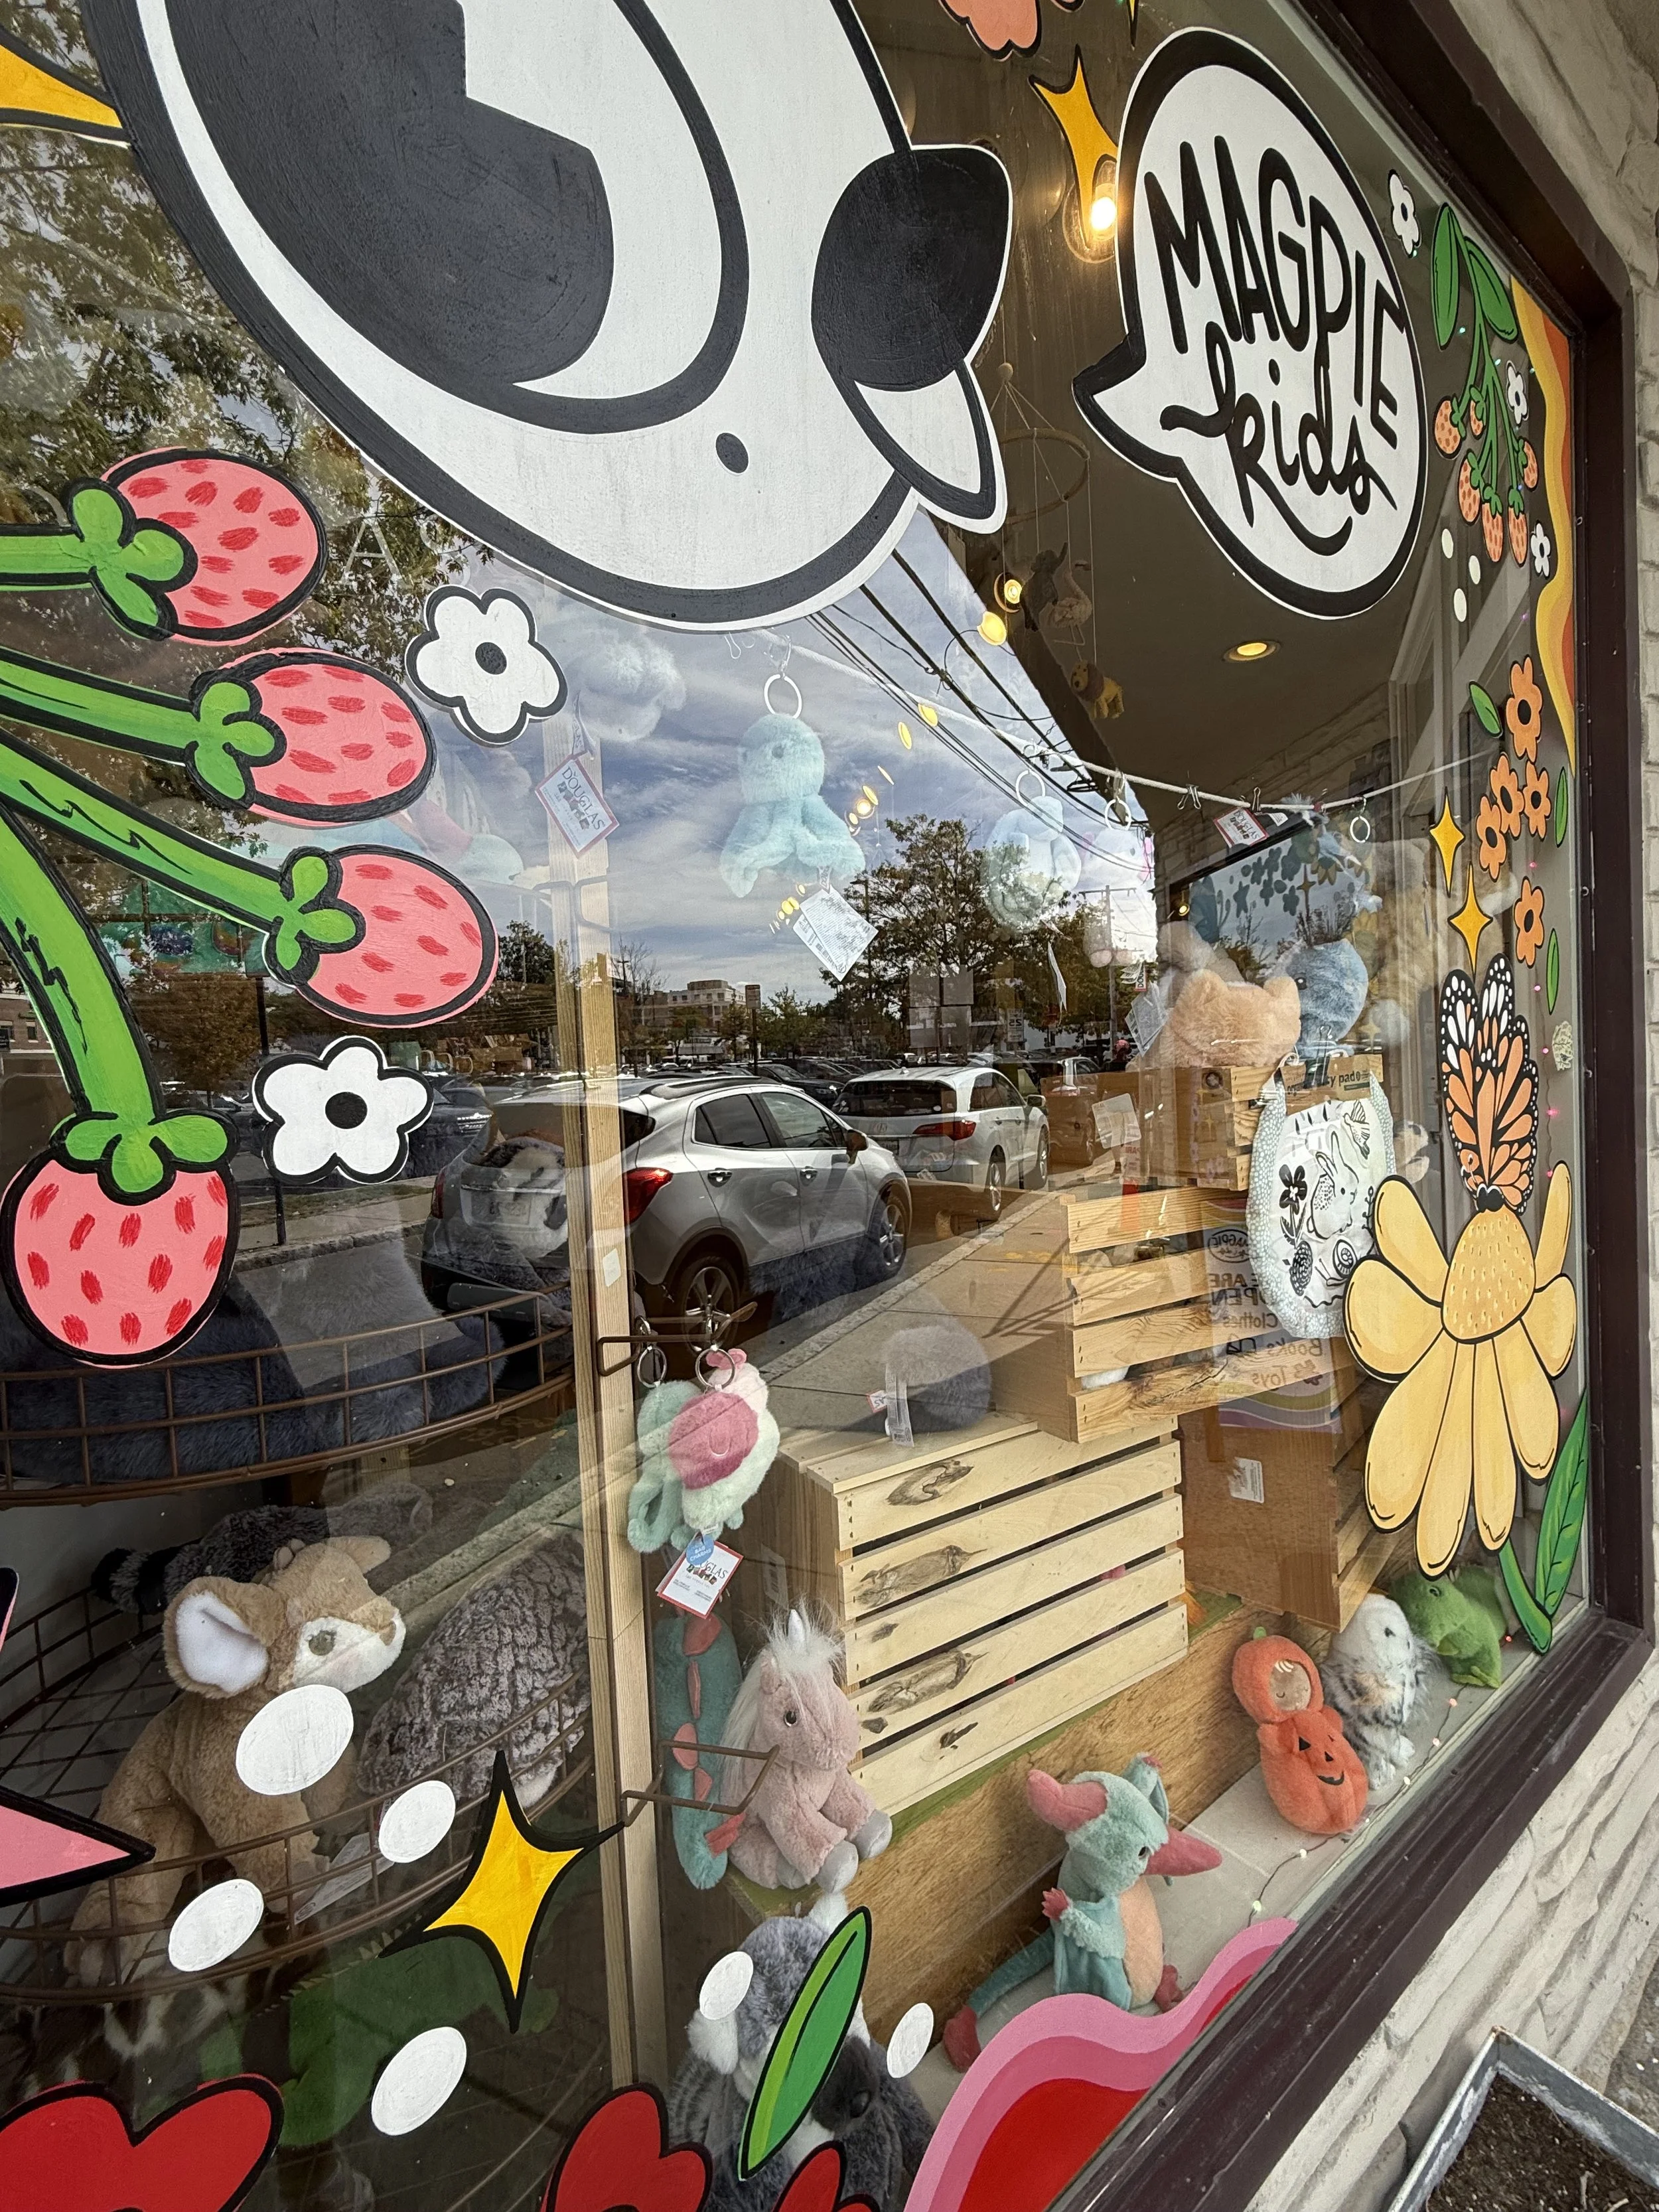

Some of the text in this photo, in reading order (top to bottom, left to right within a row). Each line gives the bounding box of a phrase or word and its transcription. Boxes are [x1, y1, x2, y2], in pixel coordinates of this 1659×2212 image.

[1145, 135, 1406, 451] MAGPIE
[1159, 321, 1398, 557] kids
[561, 767, 606, 830] DOUGLAS
[1233, 809, 1260, 840] DOUGLAS
[1338, 1070, 1355, 1087] pad
